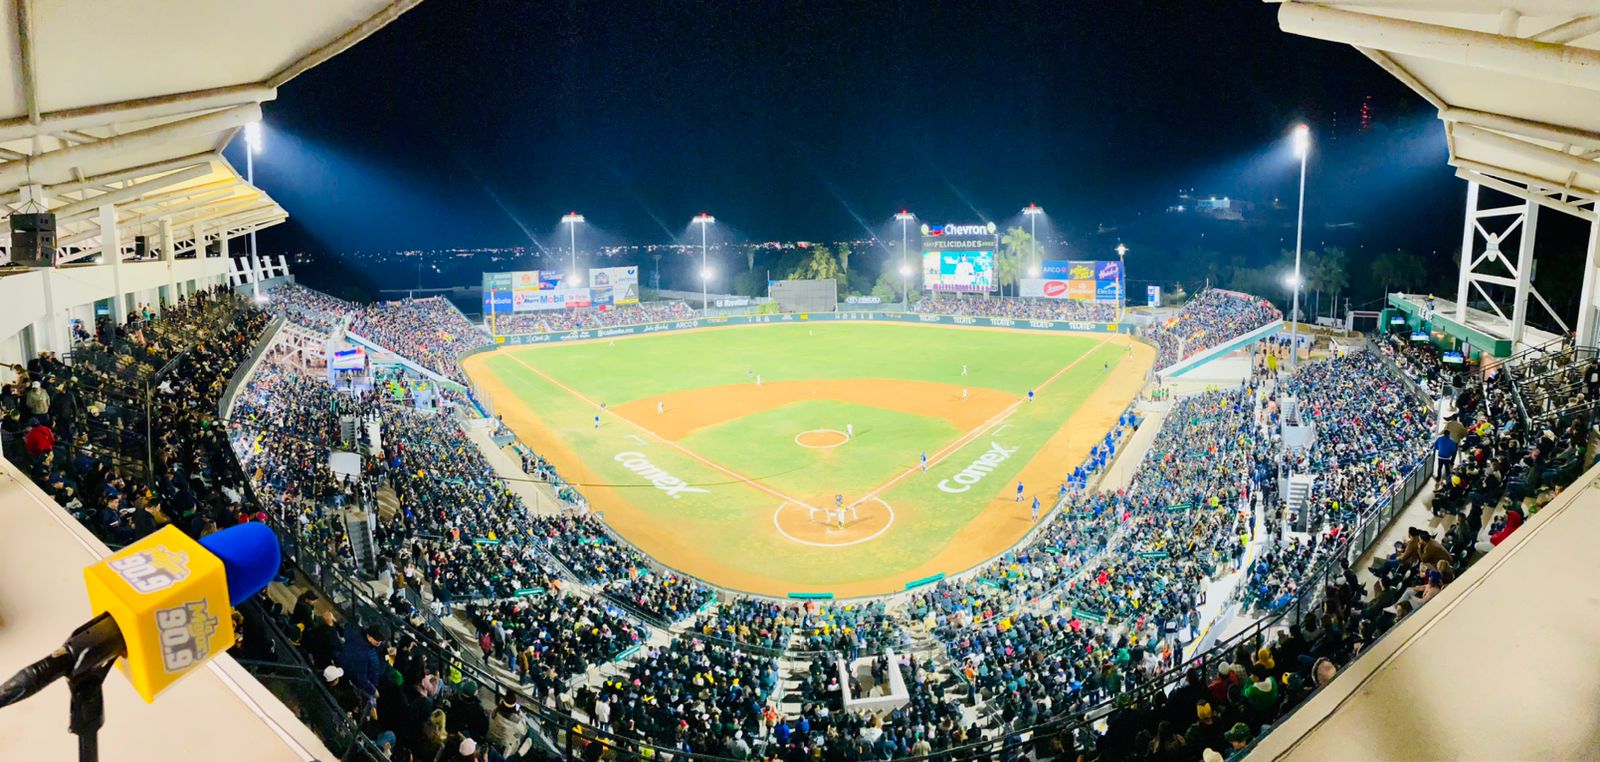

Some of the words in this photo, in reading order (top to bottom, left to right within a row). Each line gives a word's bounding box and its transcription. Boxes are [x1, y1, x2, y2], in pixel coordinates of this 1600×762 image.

[945, 224, 987, 235] Chevron
[540, 294, 565, 303] Mobil
[613, 451, 710, 499] Comex
[937, 441, 1020, 493] Comex
[109, 552, 173, 593] 90.9
[157, 607, 193, 672] 90.9
